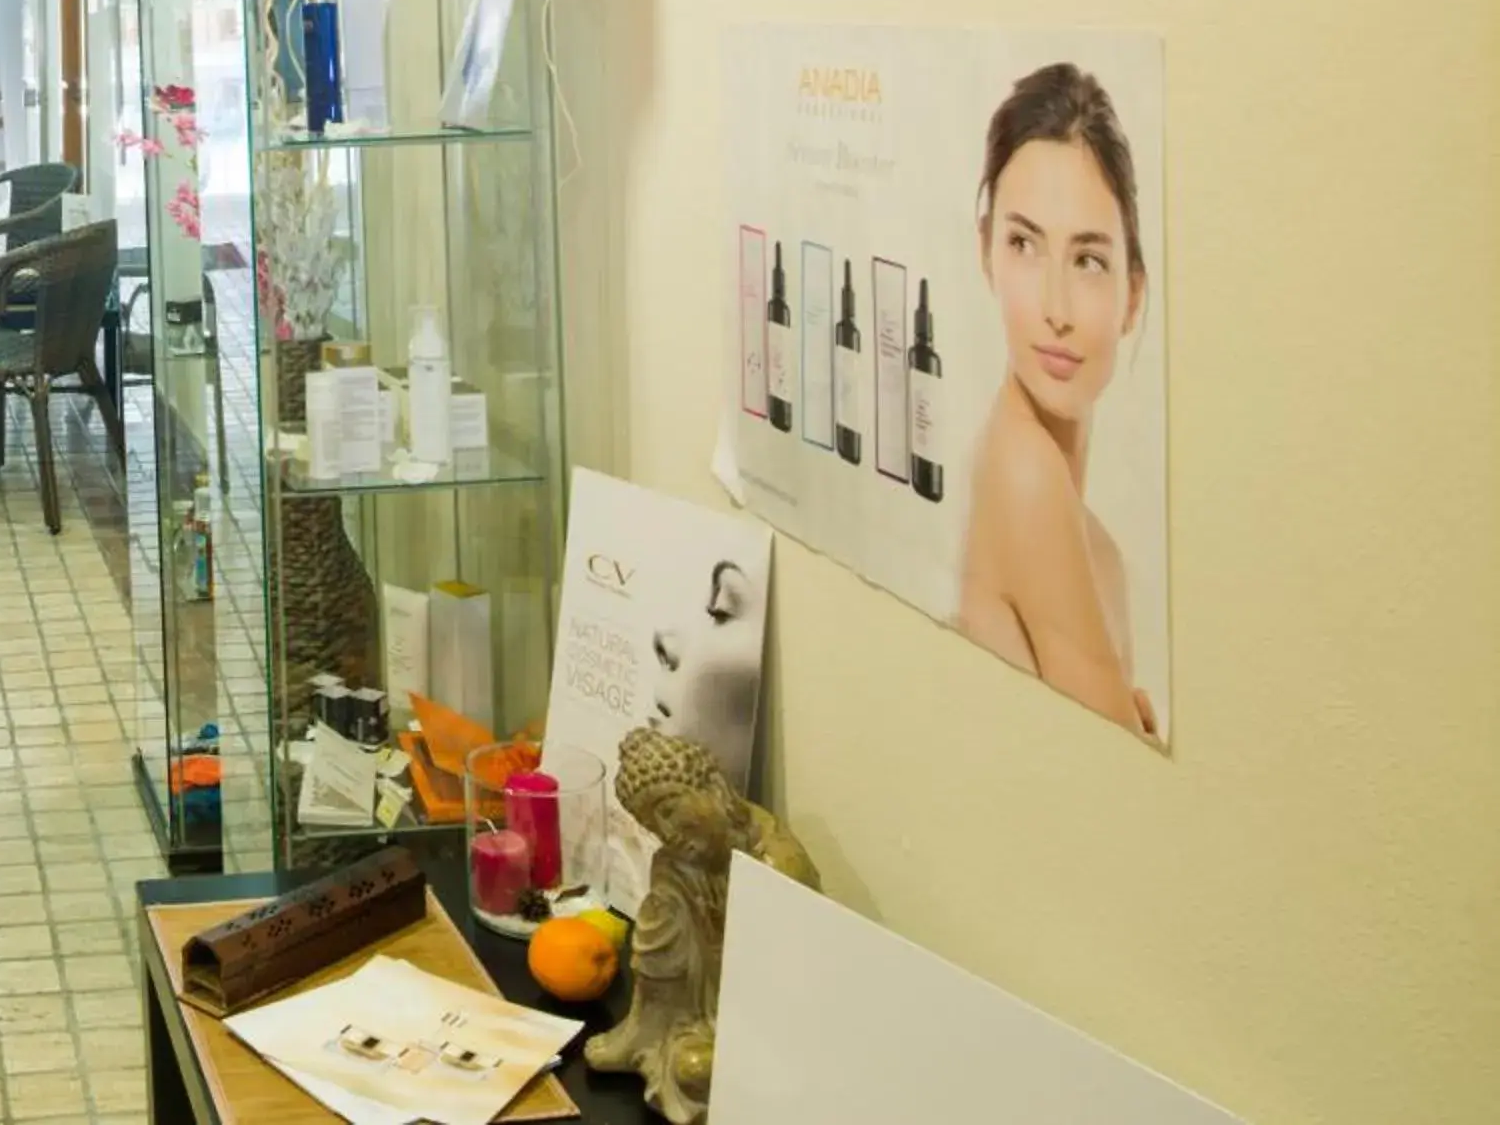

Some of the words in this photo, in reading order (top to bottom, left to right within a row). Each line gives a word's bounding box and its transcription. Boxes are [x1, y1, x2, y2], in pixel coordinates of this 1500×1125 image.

[798, 67, 882, 104] ANADIA
[587, 554, 636, 586] CV
[569, 617, 639, 665] NATURAL
[567, 663, 636, 718] VISAGE
